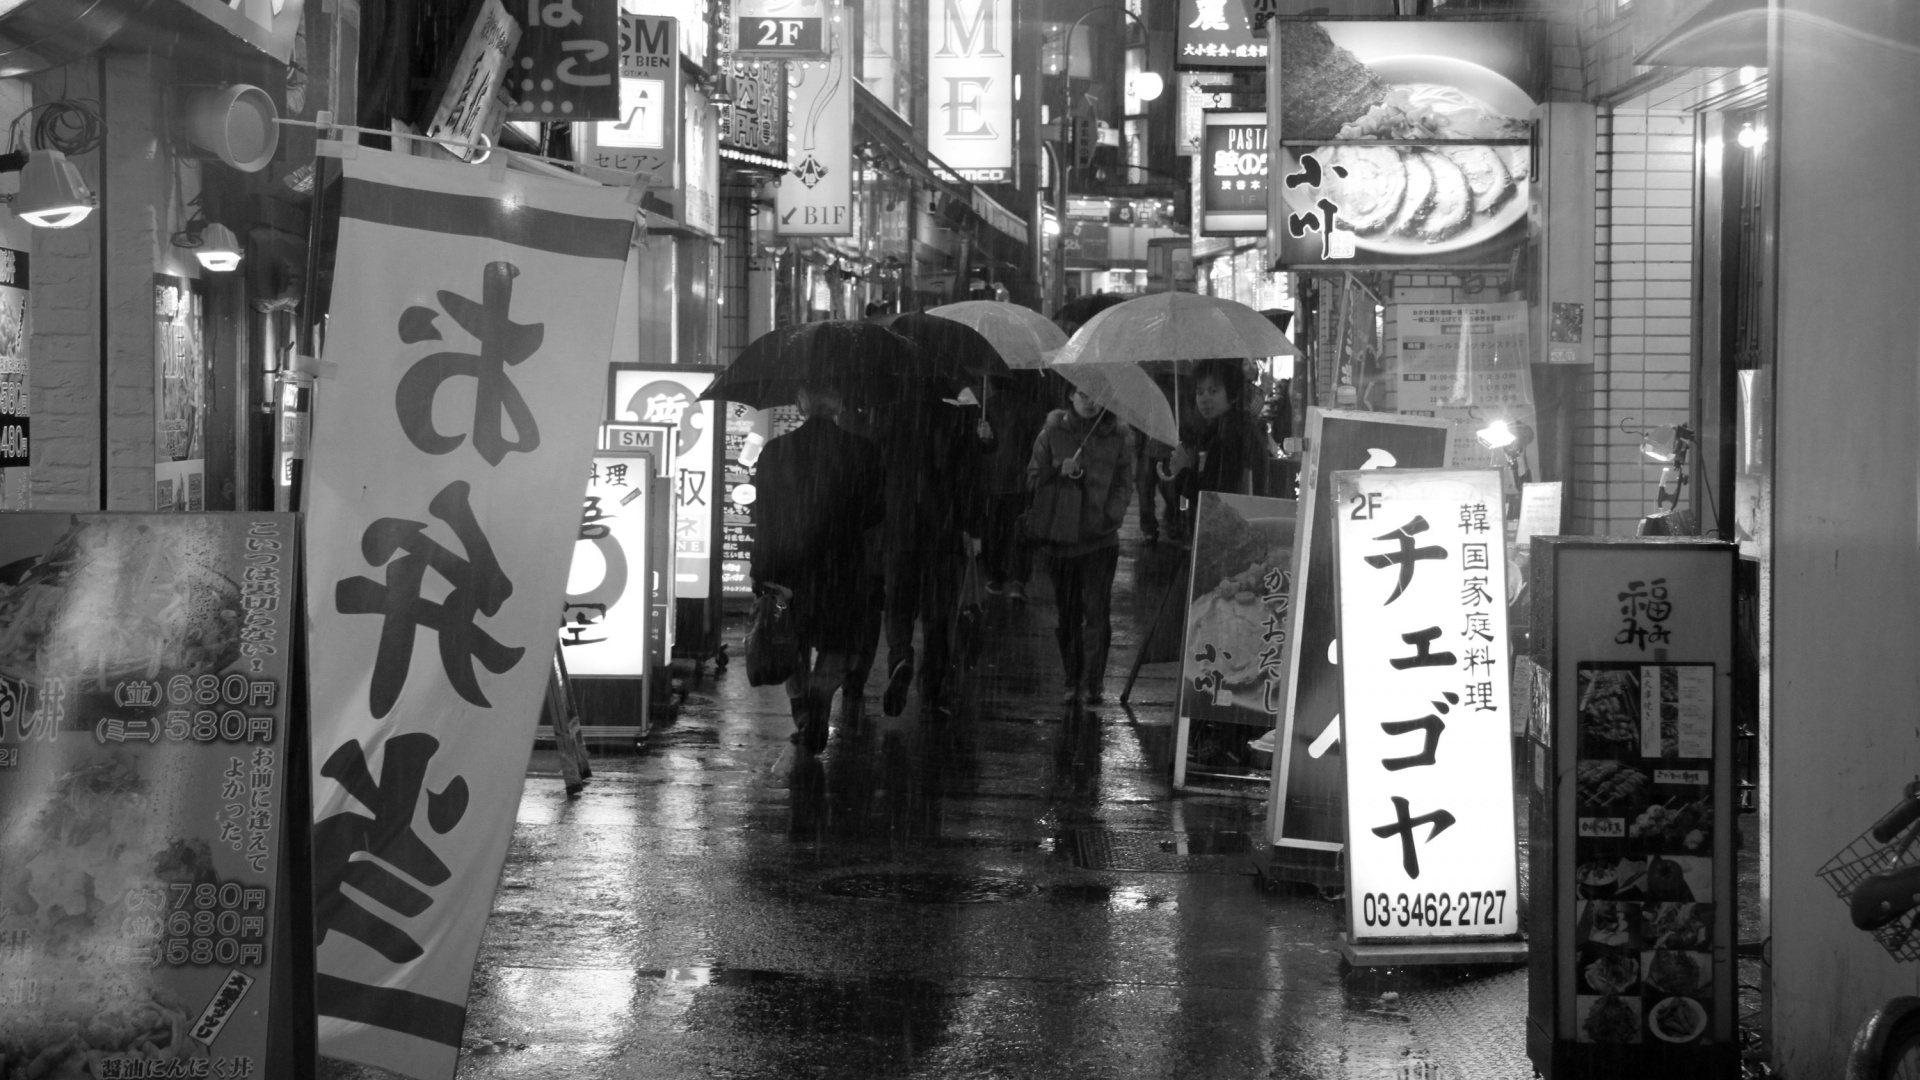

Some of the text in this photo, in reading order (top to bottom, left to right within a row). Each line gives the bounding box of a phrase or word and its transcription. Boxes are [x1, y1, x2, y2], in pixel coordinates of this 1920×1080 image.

[758, 20, 803, 46] 2F
[636, 55, 670, 68] BIEN
[594, 153, 666, 171] セビアン
[1221, 180, 1268, 190] 渋谷本
[803, 206, 846, 225] B1F
[1285, 153, 1349, 260] 小川
[1, 424, 28, 458] 480円
[623, 431, 650, 446] SM
[1350, 492, 1382, 520] 2F
[1457, 503, 1498, 713] 韓国家庭料理
[1617, 577, 1673, 622] 福
[114, 674, 276, 707] (並)680円
[1194, 643, 1232, 706] 小川
[1363, 514, 1460, 880] チェゴヤ
[96, 709, 274, 743] (ミニ)580円
[219, 757, 245, 851] よかった。
[246, 746, 275, 873] お前に逢えて
[1363, 890, 1507, 928] 03-3462-2727
